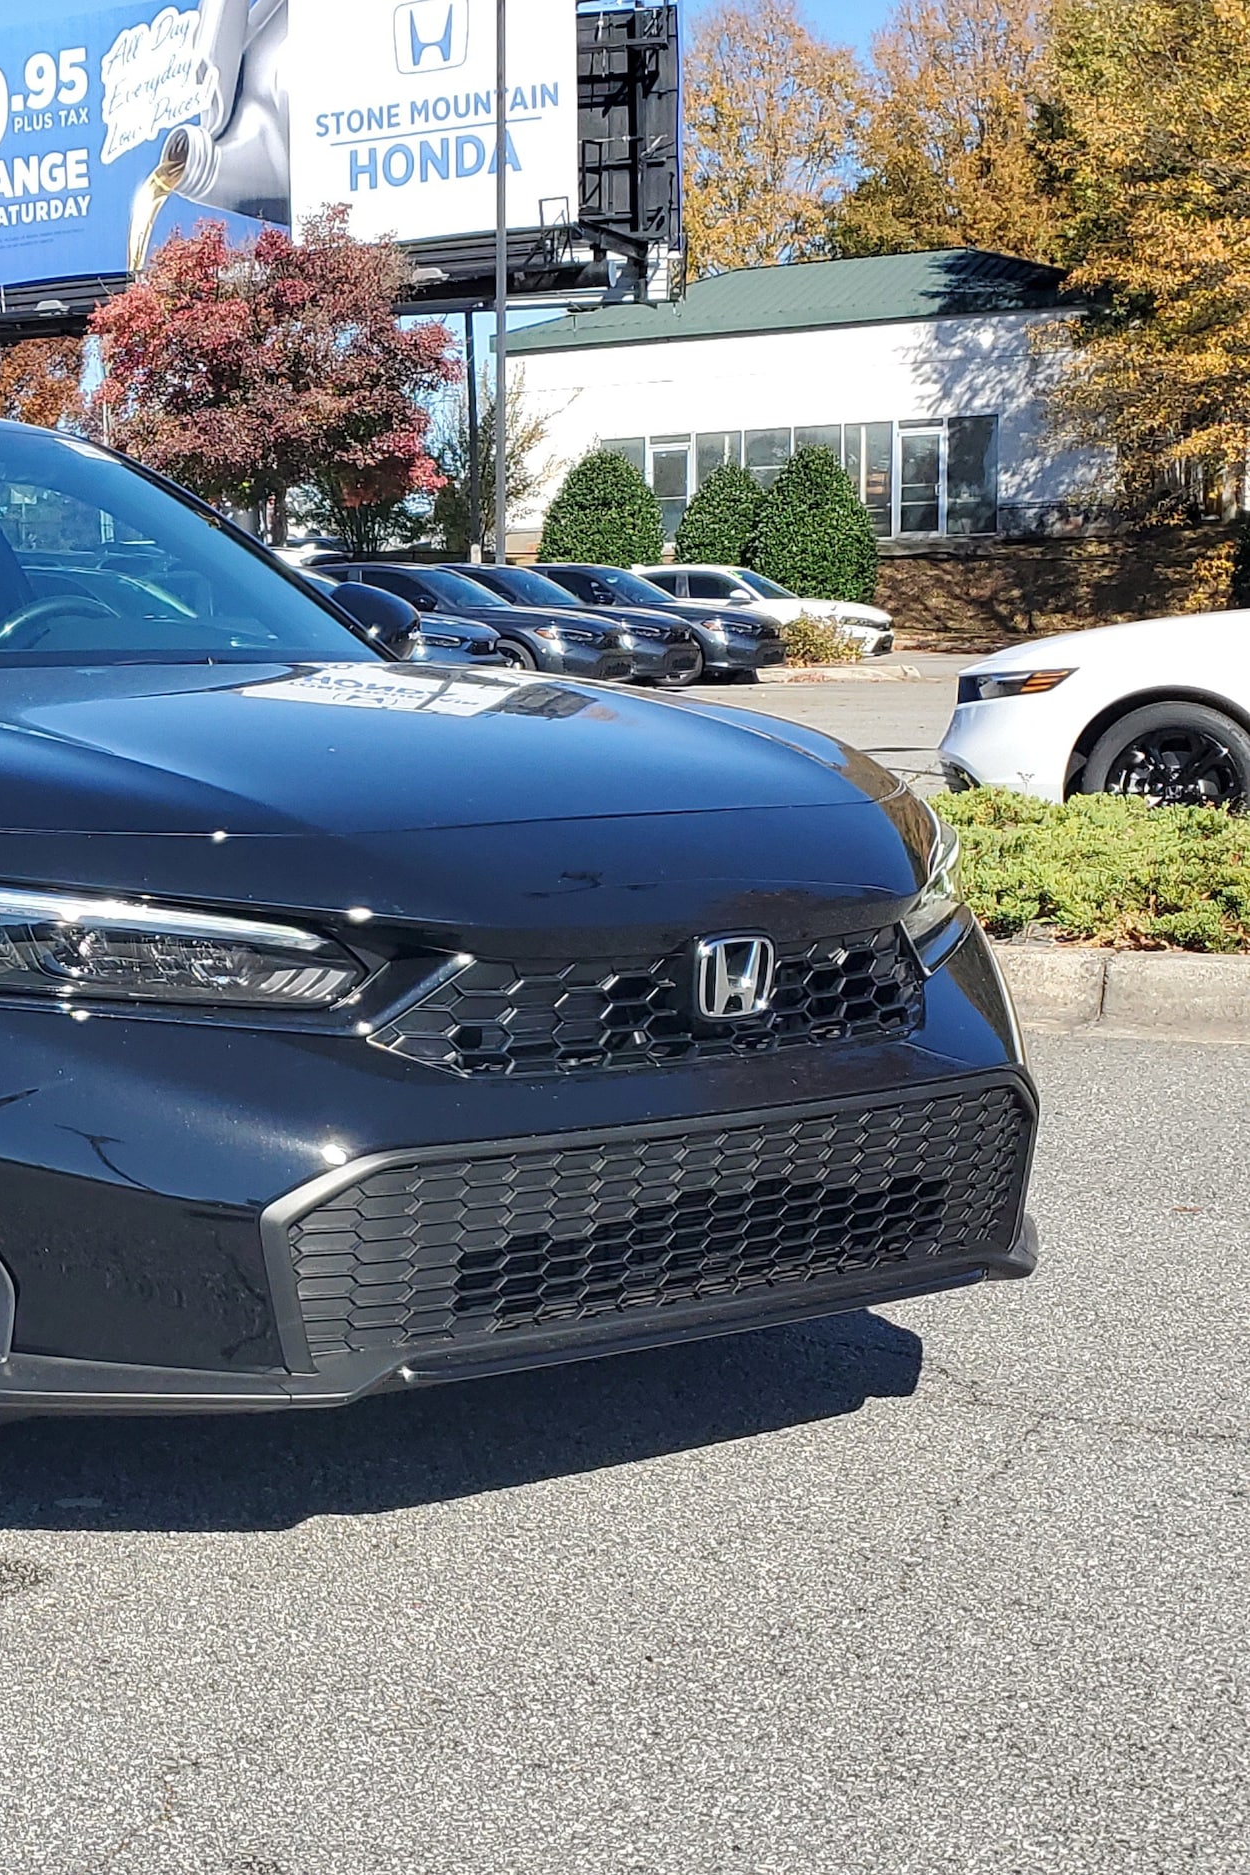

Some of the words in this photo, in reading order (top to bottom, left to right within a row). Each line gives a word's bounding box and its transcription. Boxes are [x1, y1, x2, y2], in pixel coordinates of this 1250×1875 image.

[107, 31, 144, 75] All
[151, 14, 190, 51] Day
[108, 54, 192, 115] Everyday
[13, 112, 53, 133] PLUS
[59, 107, 89, 126] TAX
[315, 104, 401, 137] STONE
[350, 128, 522, 191] HONDA
